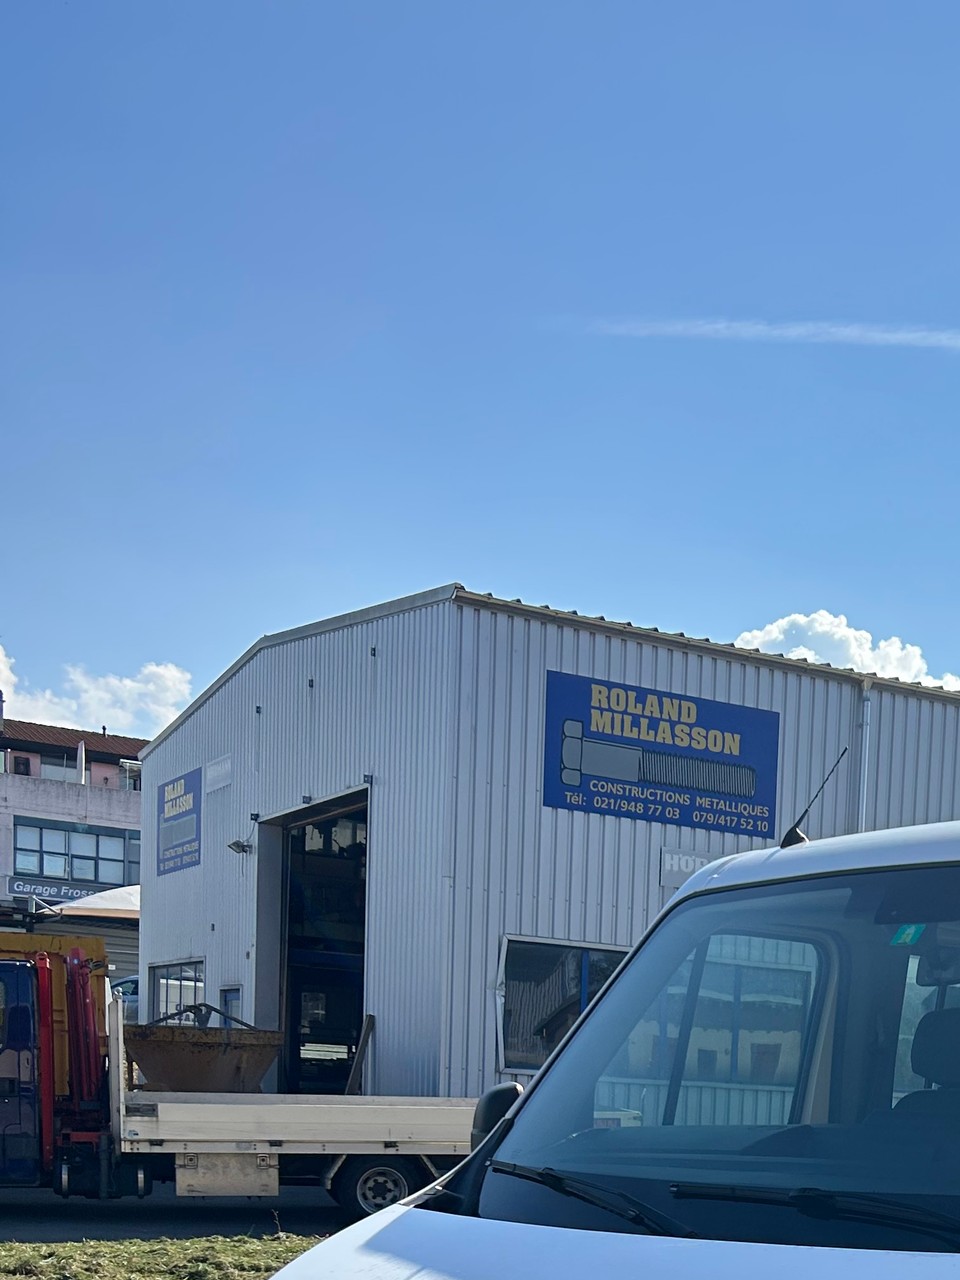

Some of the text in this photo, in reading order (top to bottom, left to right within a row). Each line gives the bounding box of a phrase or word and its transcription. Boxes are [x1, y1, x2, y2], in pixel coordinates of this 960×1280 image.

[590, 683, 698, 724] ROLAND
[590, 709, 741, 756] MILLASSON
[564, 791, 769, 832] Tél: 021/948 77 03 079/417 52 10
[590, 779, 770, 818] CONSTRUCTIONS METALLIQUES
[13, 881, 58, 896] Garage
